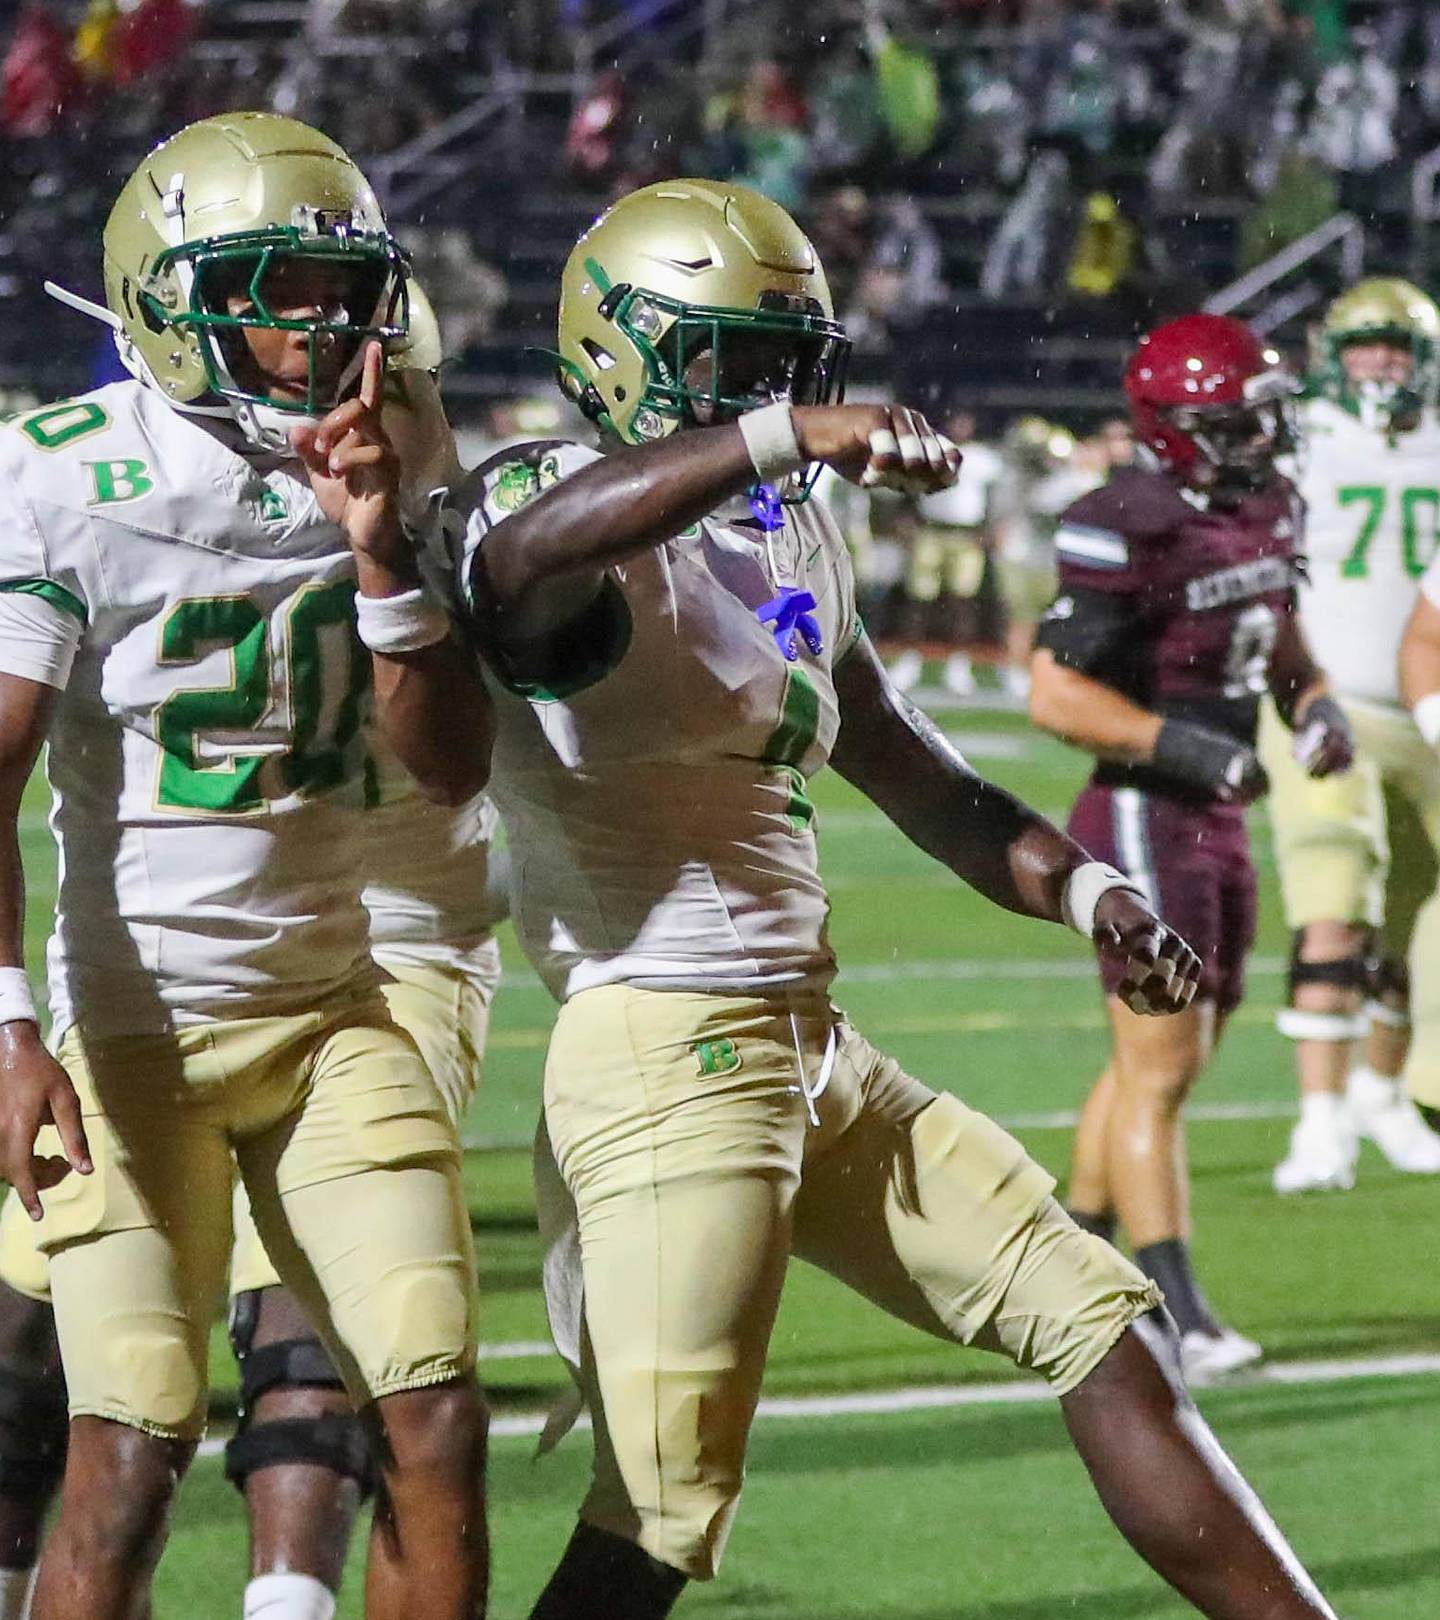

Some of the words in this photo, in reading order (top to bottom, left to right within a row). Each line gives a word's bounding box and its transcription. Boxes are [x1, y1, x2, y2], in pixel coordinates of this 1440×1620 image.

[80, 456, 156, 509] B
[1337, 486, 1440, 580] 70
[151, 577, 370, 818] 20
[687, 1037, 743, 1082] B
